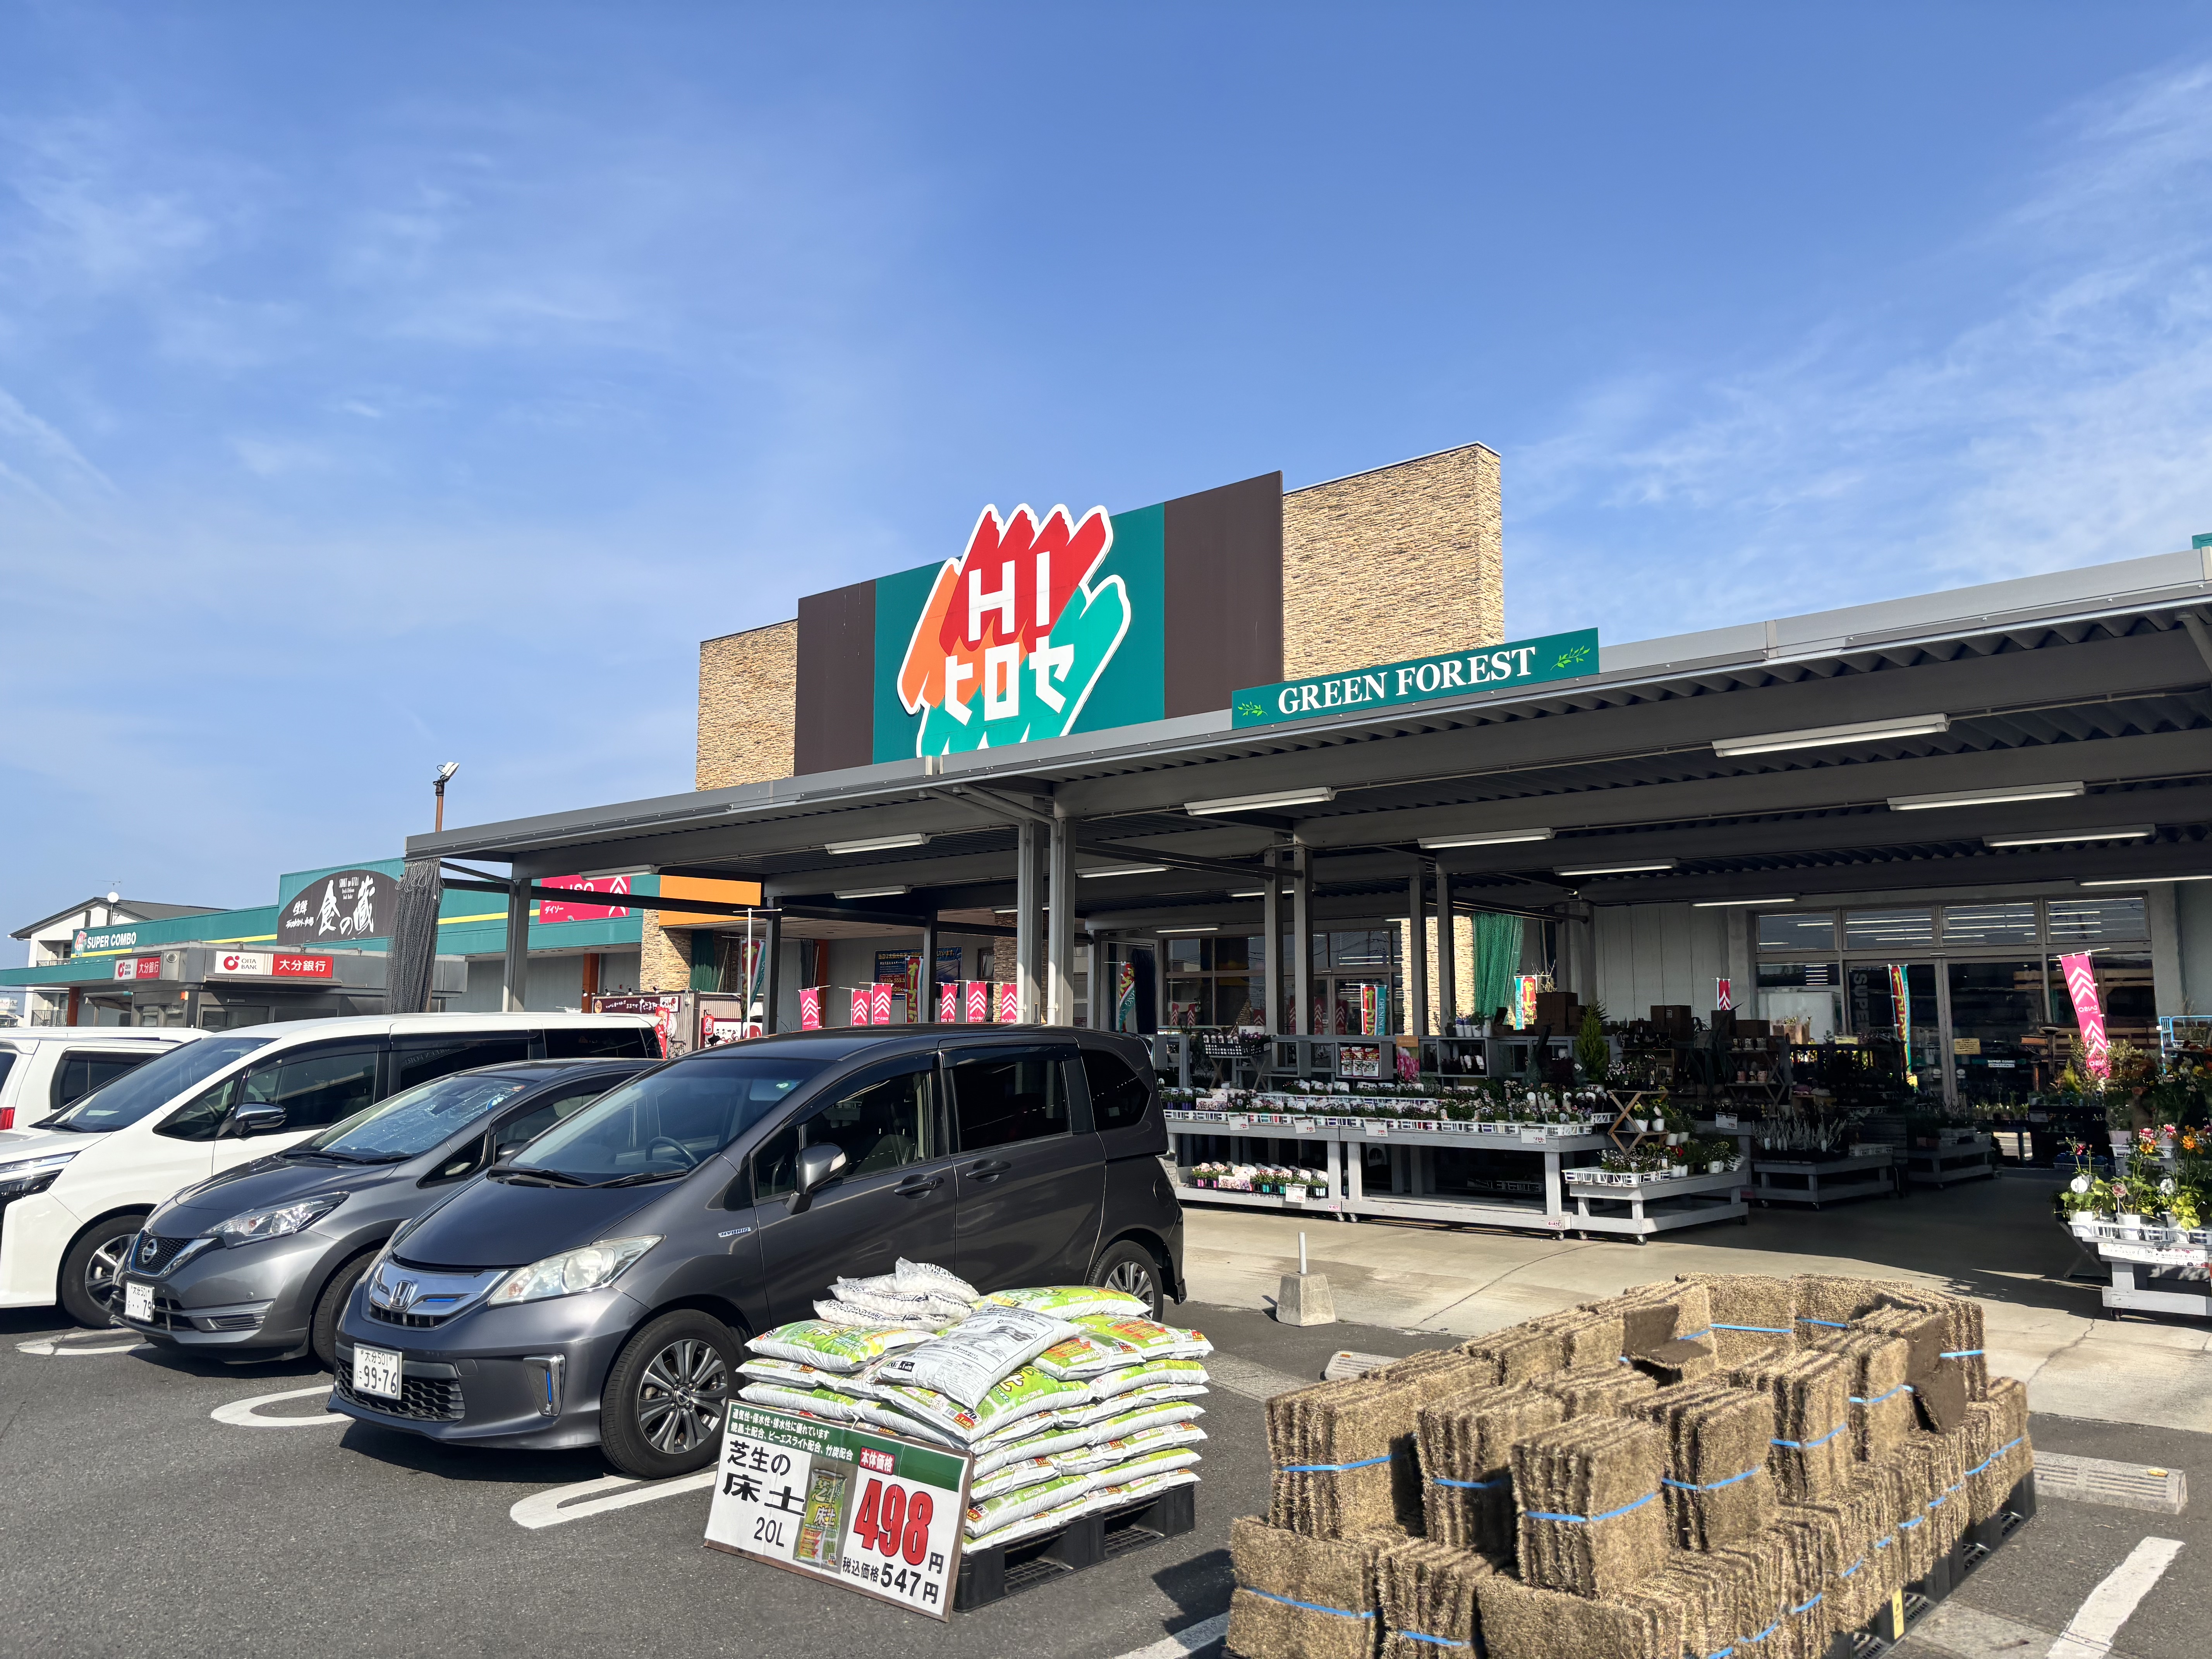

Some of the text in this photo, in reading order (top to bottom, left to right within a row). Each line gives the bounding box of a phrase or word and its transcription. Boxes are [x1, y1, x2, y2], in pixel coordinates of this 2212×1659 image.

[968, 551, 1050, 642] HI
[945, 635, 1074, 726] ヒロセ
[1278, 646, 1535, 714] GREEN FOREST
[545, 905, 564, 914] ダイソー
[87, 932, 137, 949] SUPER COMBO
[138, 961, 159, 974] 大分銀行
[279, 959, 326, 972] 大分銀行
[721, 1228, 749, 1236] HYBRID
[143, 1300, 152, 1318] 79
[364, 1365, 397, 1394] 99-76
[727, 1440, 791, 1476] 芝生の
[860, 1448, 893, 1473] 本体価格
[722, 1473, 805, 1517] 床土
[753, 1516, 785, 1547] 20L
